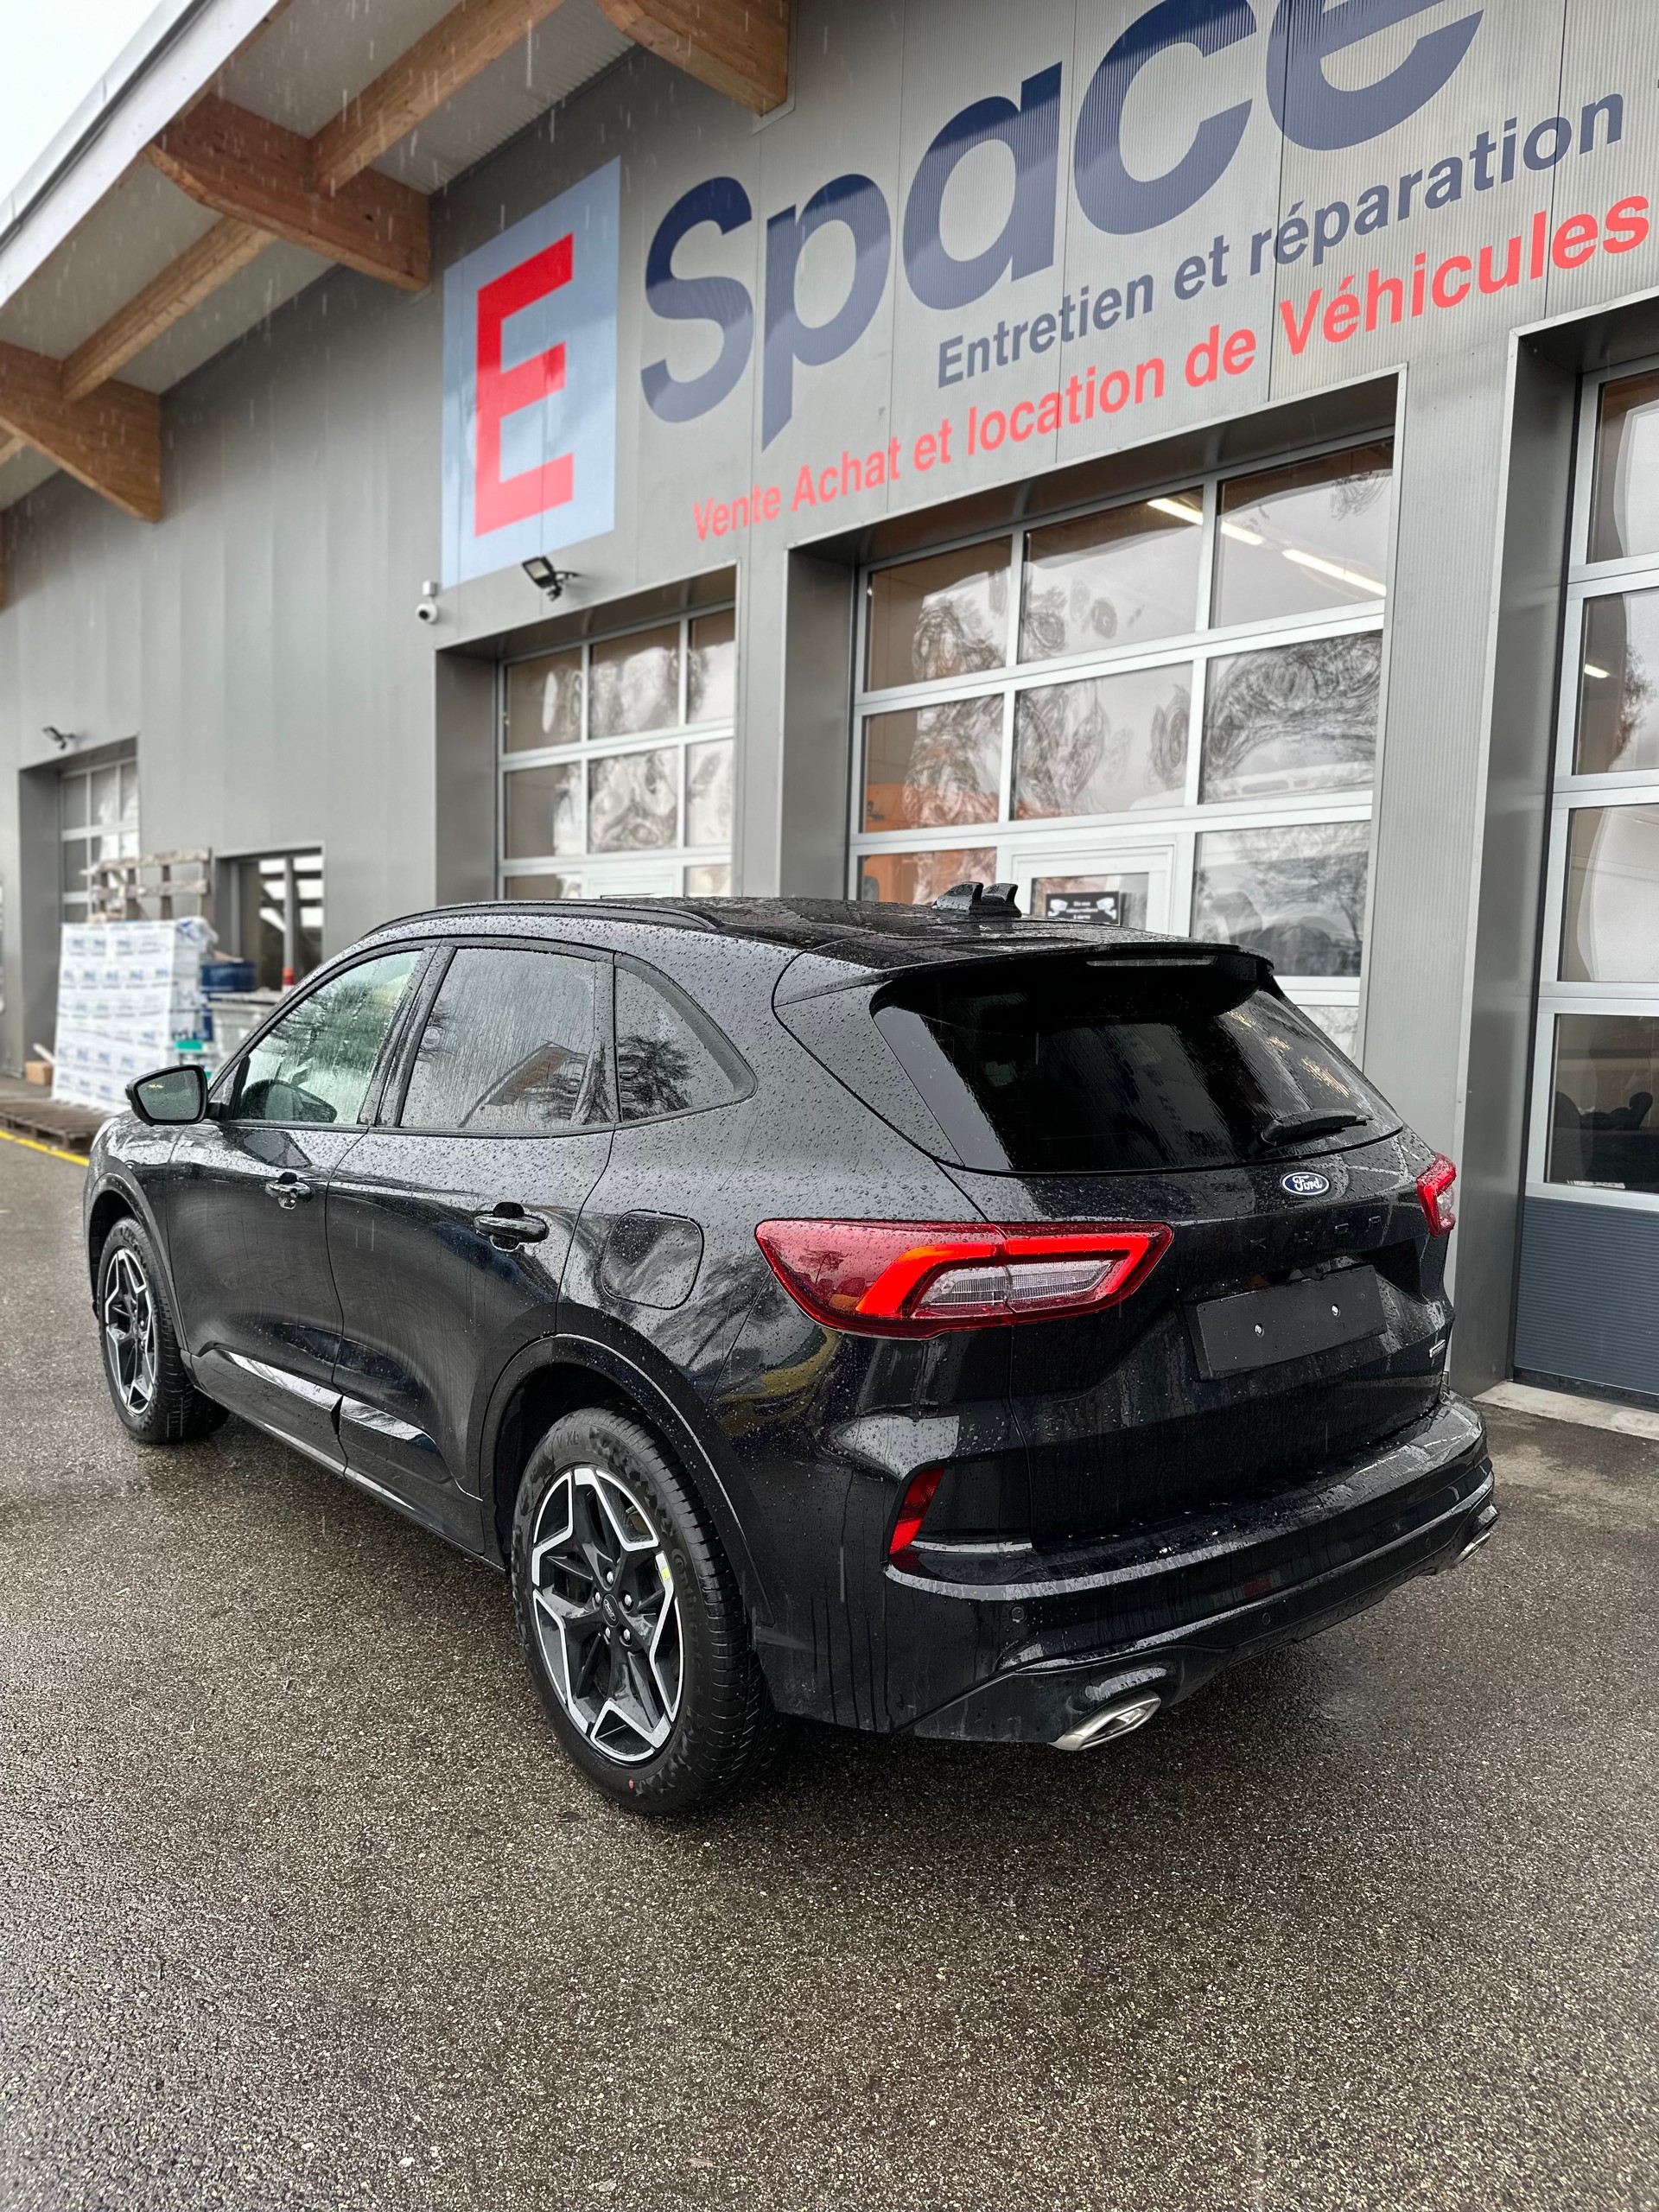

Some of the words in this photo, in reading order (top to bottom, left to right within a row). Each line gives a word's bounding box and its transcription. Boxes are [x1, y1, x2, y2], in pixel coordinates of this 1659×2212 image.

[474, 232, 574, 537] E
[640, 0, 1483, 450] Space
[693, 485, 781, 541] Vente
[791, 437, 901, 512] Achat
[913, 418, 953, 472] et
[966, 359, 1165, 456] location
[1185, 324, 1256, 388] de
[1279, 194, 1649, 355] Véhicules
[938, 275, 1154, 388] Entretien
[1174, 236, 1230, 302] et
[1250, 93, 1624, 275] réparation
